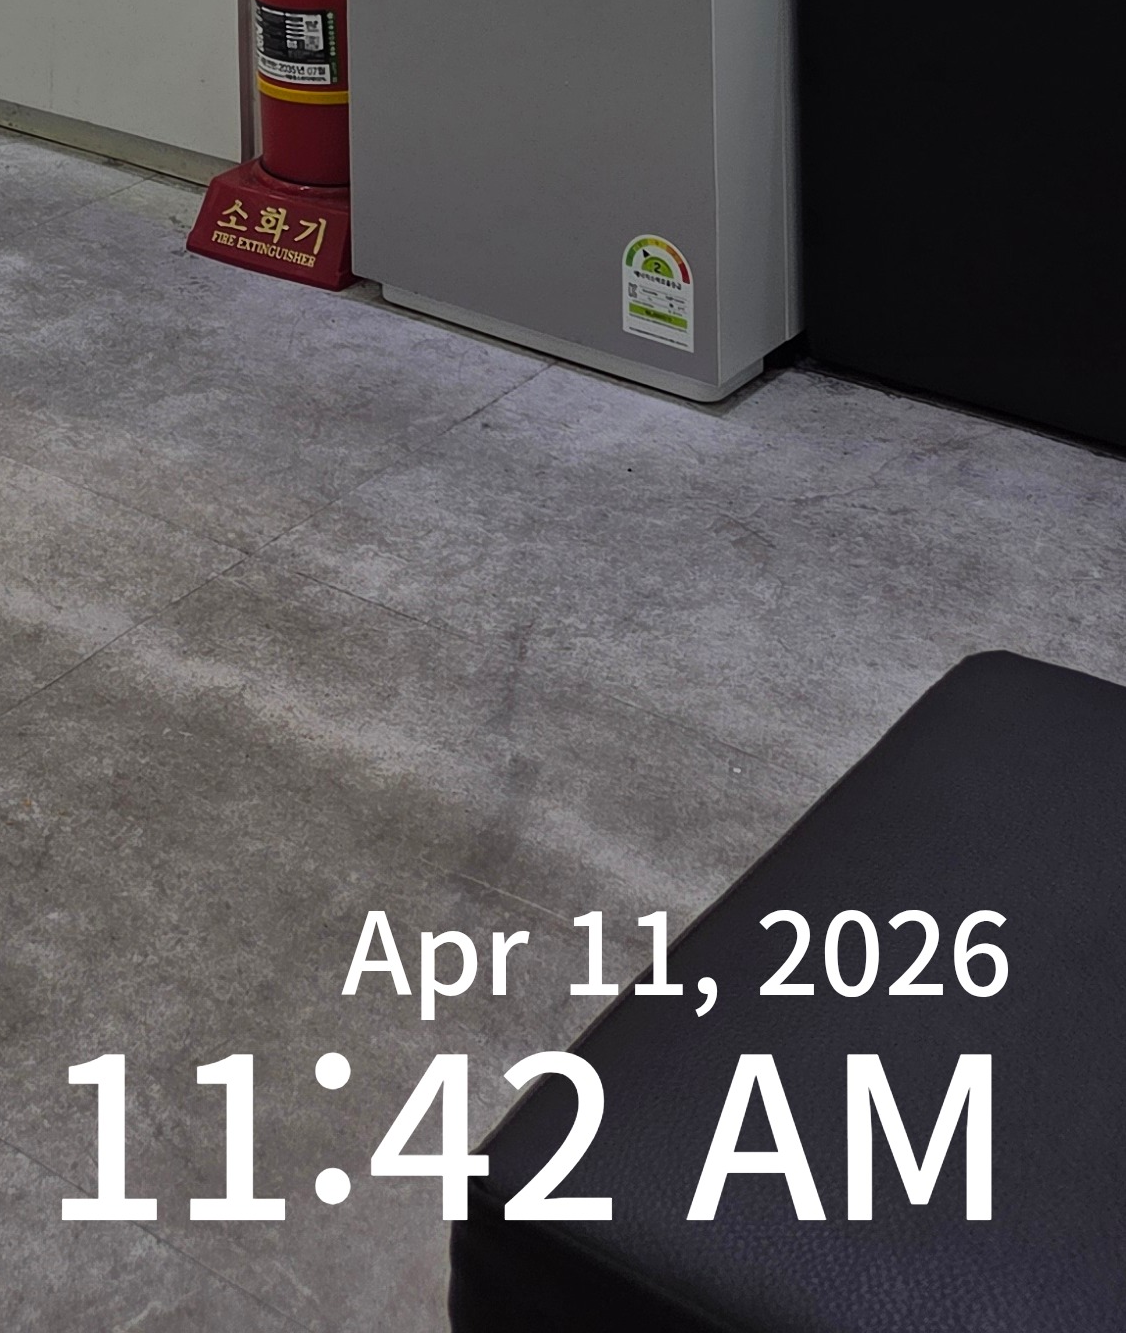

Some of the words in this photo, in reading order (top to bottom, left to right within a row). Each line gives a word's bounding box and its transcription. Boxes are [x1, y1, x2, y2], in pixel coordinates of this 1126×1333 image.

[217, 199, 327, 255] 소화기
[212, 230, 236, 246] FIRE
[237, 236, 316, 268] EXTINGUISHER
[654, 262, 662, 273] 2
